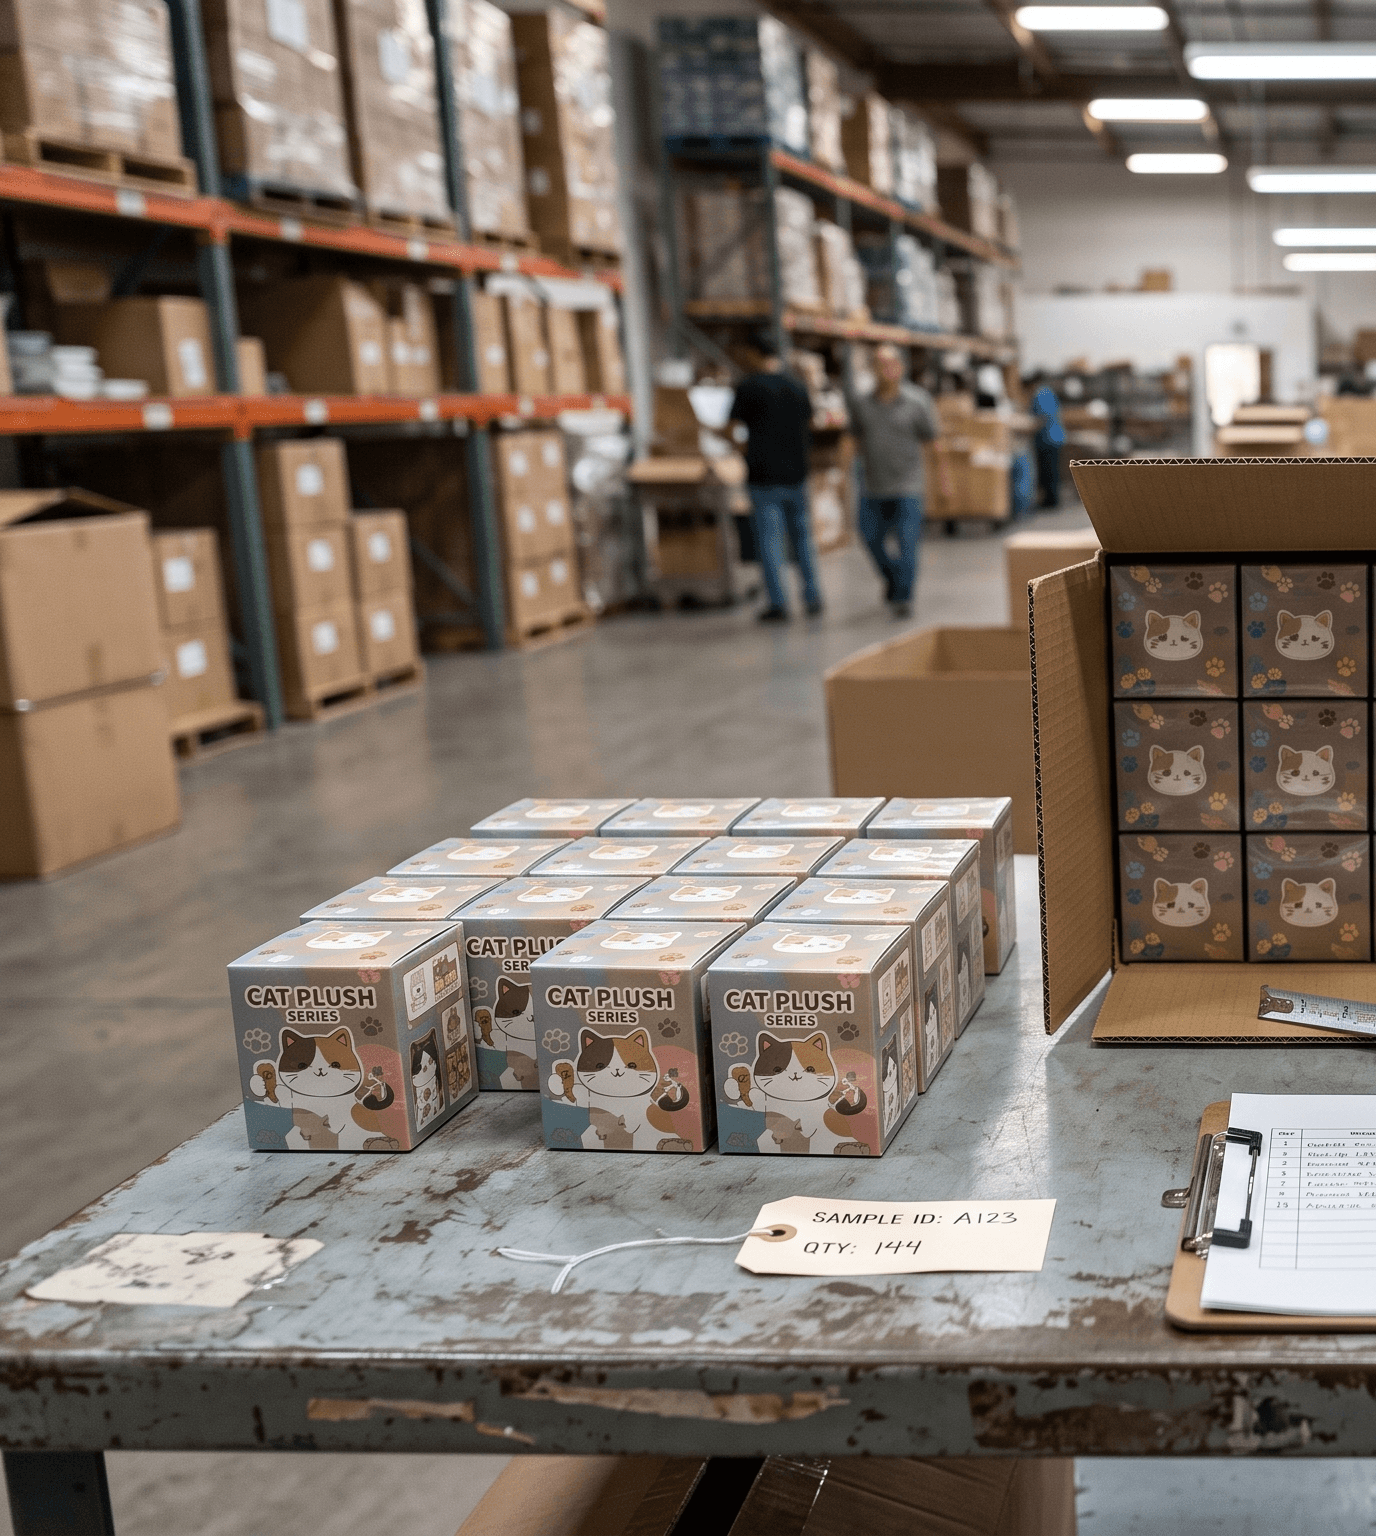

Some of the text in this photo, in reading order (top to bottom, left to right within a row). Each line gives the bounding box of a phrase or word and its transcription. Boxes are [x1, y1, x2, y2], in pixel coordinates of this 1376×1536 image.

[465, 937, 566, 957] CAT PLU
[503, 959, 533, 972] SER
[246, 987, 375, 1008] CAT PLUSH
[547, 987, 673, 1009] CAT PLUSH
[725, 991, 852, 1012] CAT PLUSH
[286, 1009, 339, 1023] SERIES
[587, 1010, 638, 1024] SERIES
[765, 1014, 816, 1027] SERIES
[812, 1211, 1018, 1225] SAMPLE ID: A123
[803, 1240, 923, 1255] QTY: 144
